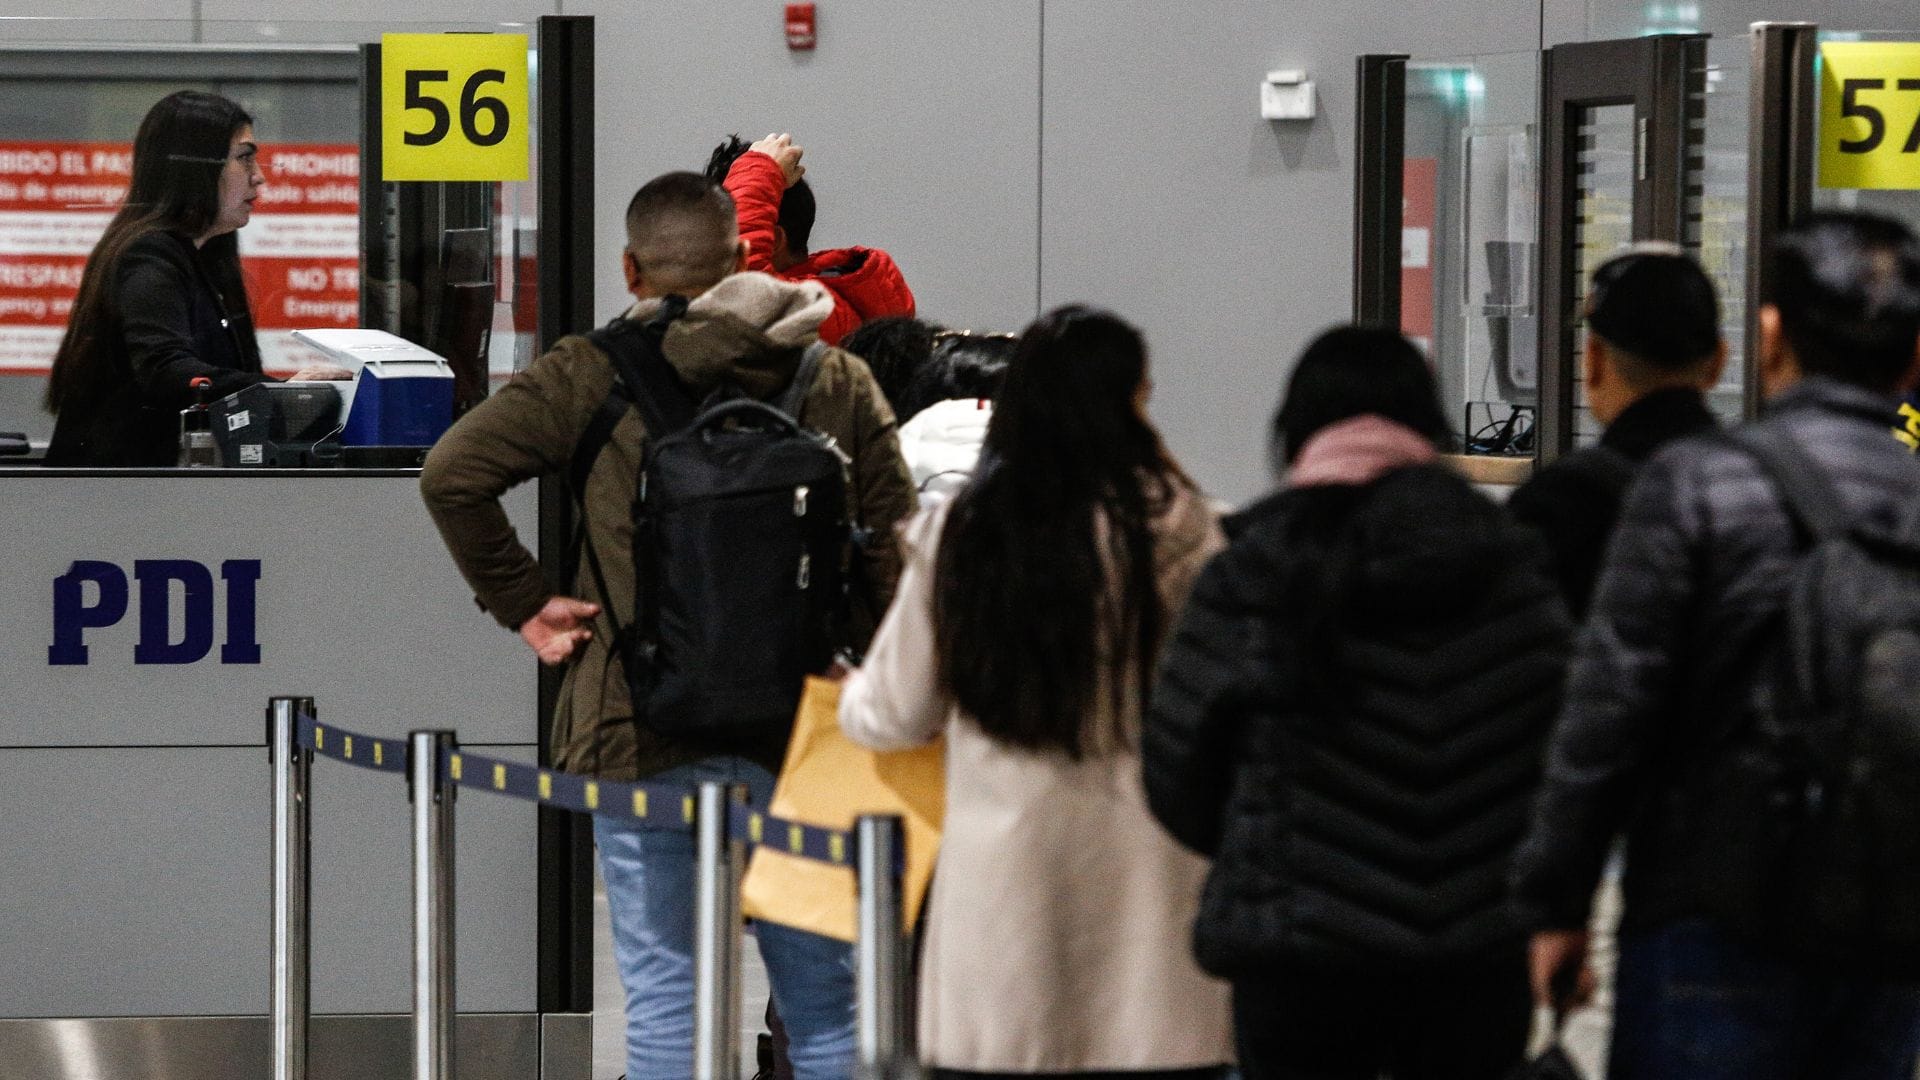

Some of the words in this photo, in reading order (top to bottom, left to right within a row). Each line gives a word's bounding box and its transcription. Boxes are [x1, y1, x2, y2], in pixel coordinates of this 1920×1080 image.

[404, 69, 510, 147] 56
[1839, 79, 1920, 153] 57
[287, 267, 328, 291] NO
[48, 559, 261, 665] PDI
